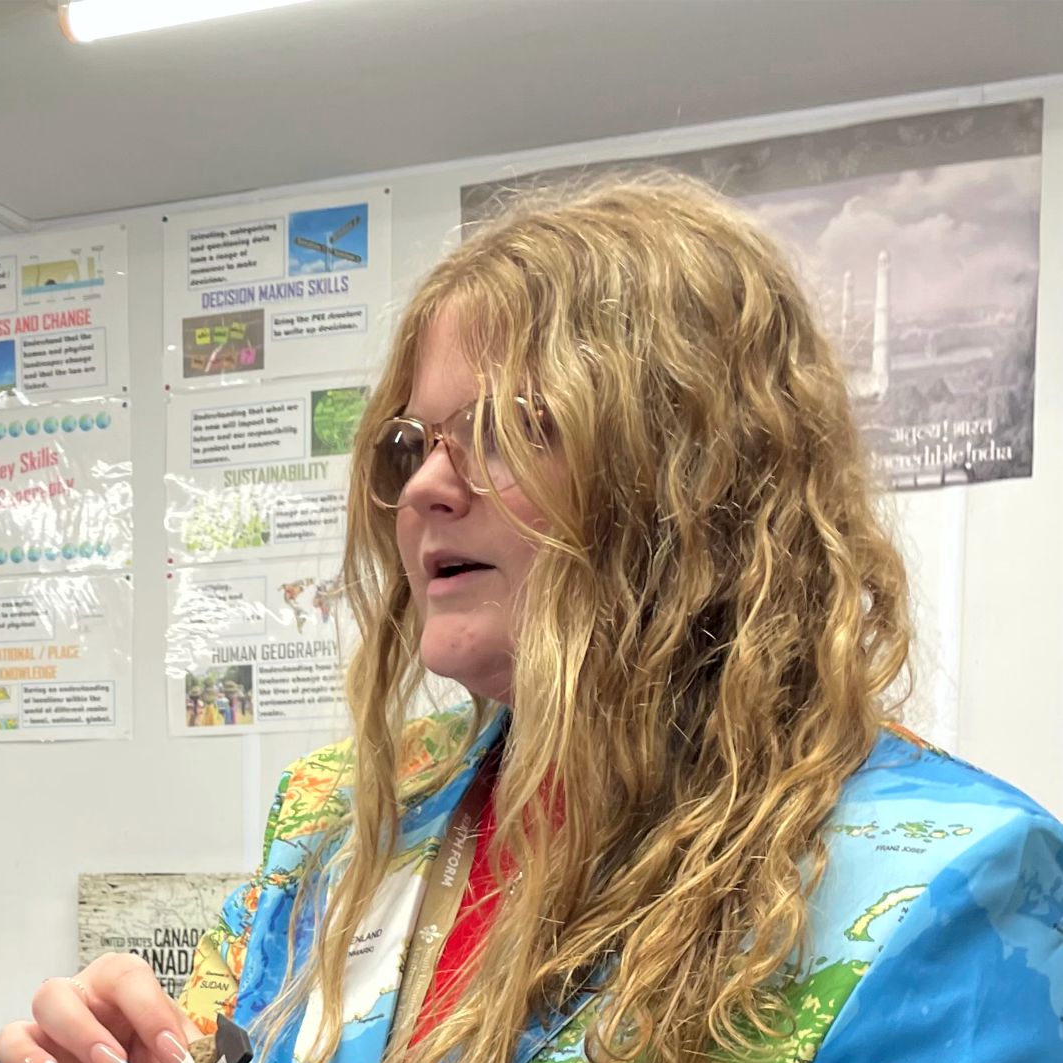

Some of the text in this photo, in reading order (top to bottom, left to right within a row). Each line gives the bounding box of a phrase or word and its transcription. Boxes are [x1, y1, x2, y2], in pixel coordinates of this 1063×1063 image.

[201, 275, 349, 310] DECISION MAKING SKILLS
[15, 315, 39, 335] AND
[43, 308, 92, 331] CHANGE
[20, 447, 58, 474] Skills
[223, 461, 329, 487] SUSTAINABILITY
[48, 644, 80, 660] PLACE
[211, 640, 338, 664] HUMAN GEOGRAPHY
[441, 847, 463, 888] FORM
[100, 936, 126, 947] UNITED
[127, 936, 152, 947] STATES
[200, 979, 230, 992] SUDAN
